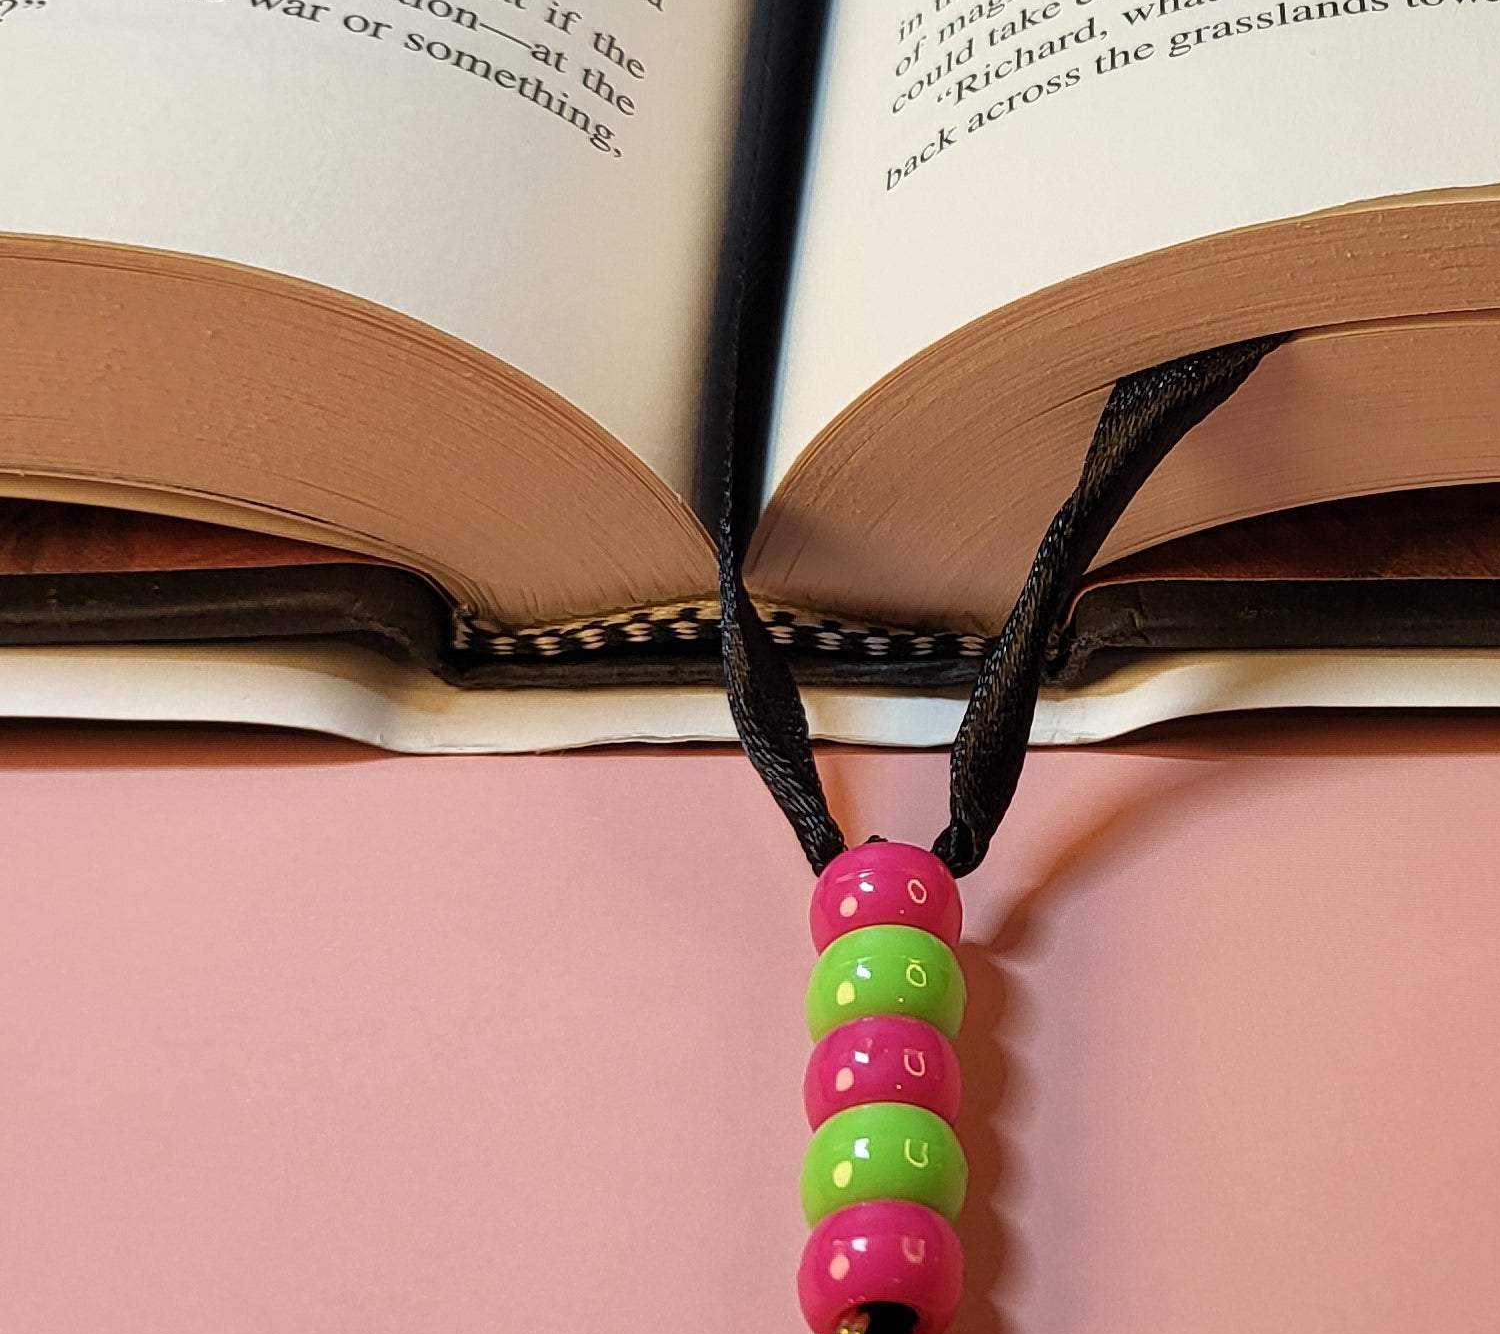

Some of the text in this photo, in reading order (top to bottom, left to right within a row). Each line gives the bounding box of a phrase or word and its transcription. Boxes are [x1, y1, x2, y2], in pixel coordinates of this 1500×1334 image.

[542, 0, 584, 36] if
[592, 30, 646, 80] the
[890, 36, 974, 115] could
[984, 0, 1062, 70] take
[894, 33, 928, 78] of
[898, 11, 924, 43] in
[935, 15, 1108, 106] “Richard,
[341, 13, 394, 41] or
[402, 31, 623, 159] something,
[580, 66, 636, 117] the
[884, 125, 958, 193] back
[966, 66, 1082, 135] across
[1093, 41, 1156, 76] the
